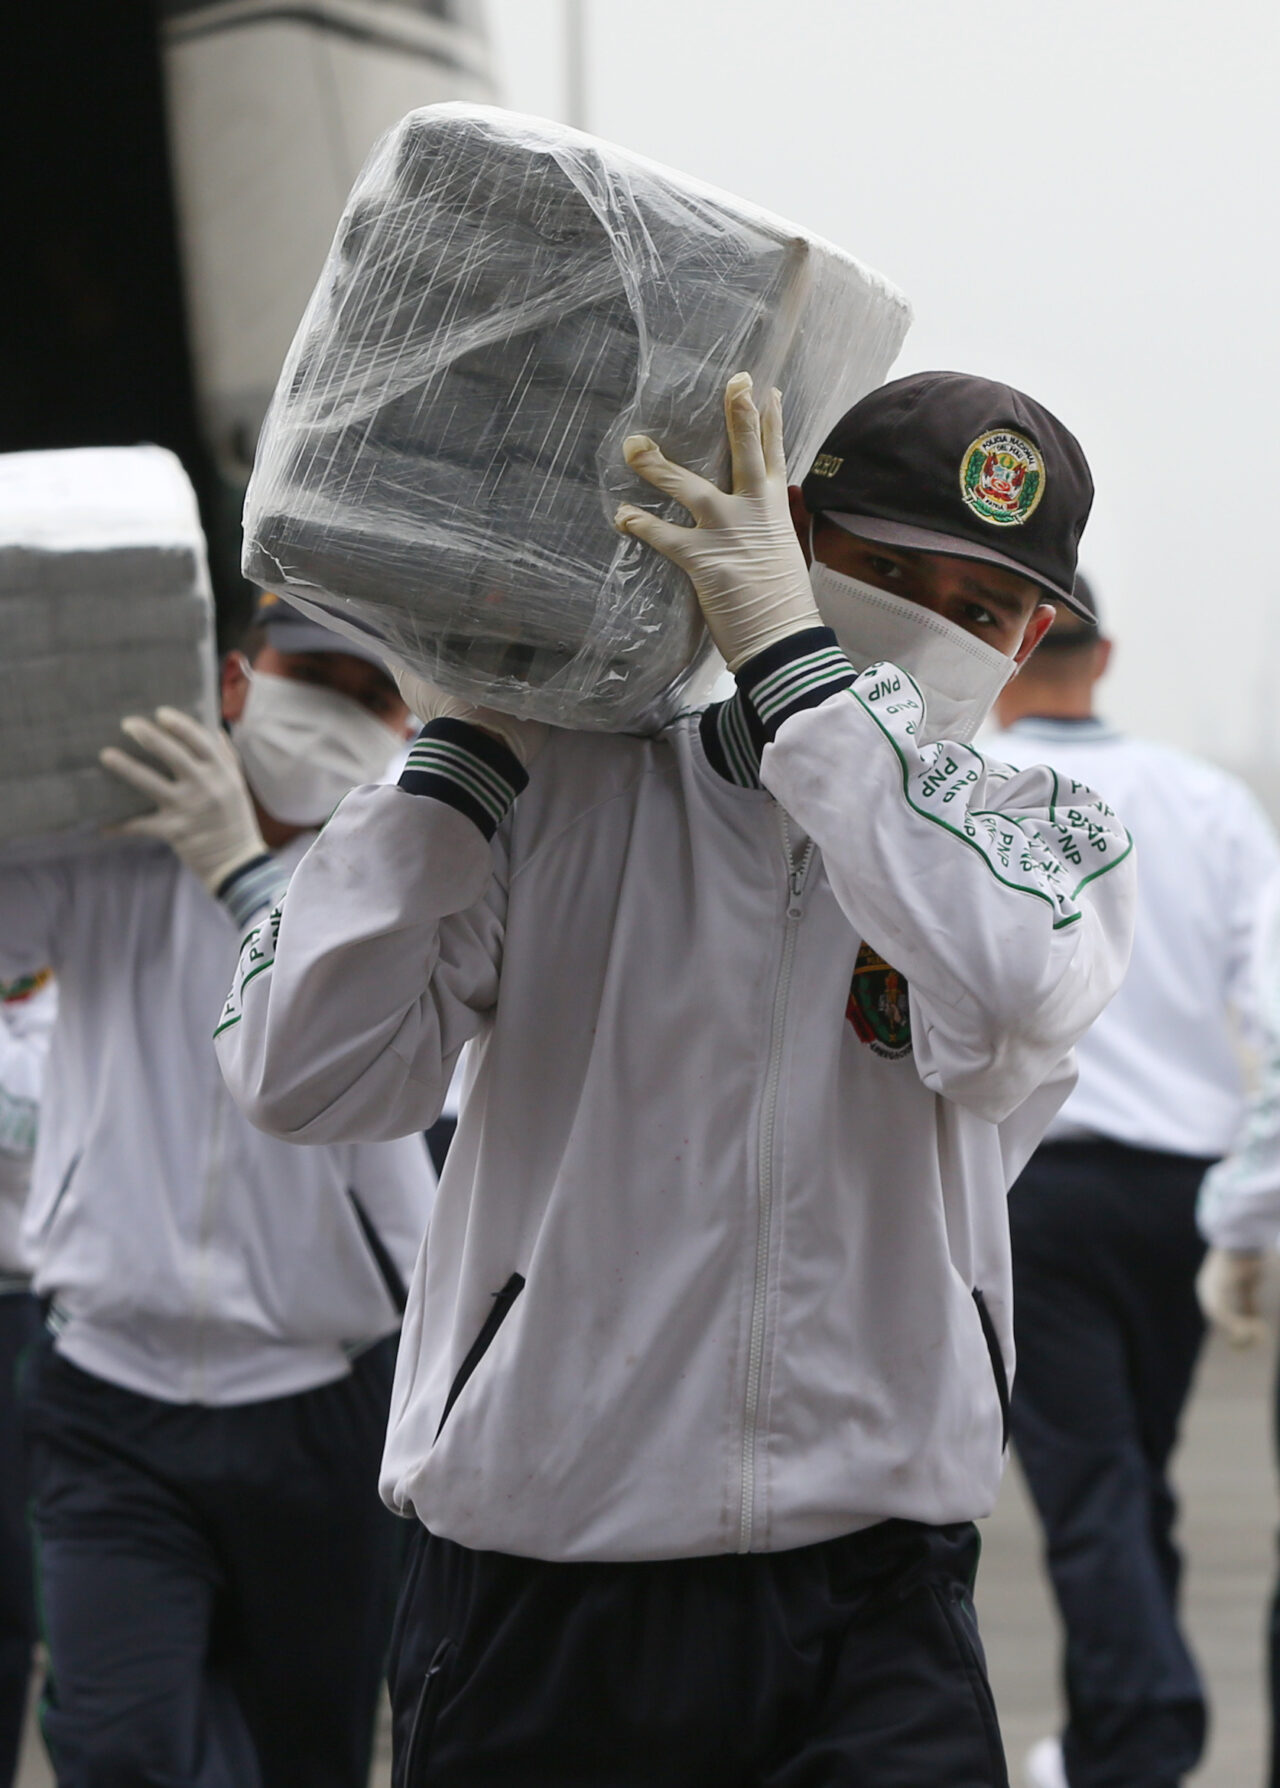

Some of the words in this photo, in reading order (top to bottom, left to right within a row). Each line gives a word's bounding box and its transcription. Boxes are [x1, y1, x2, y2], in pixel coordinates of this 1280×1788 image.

[868, 674, 901, 702] PNP
[922, 757, 958, 798] PNP
[942, 770, 978, 803] PNP
[997, 831, 1014, 868] PNP
[1051, 823, 1082, 865] PNP
